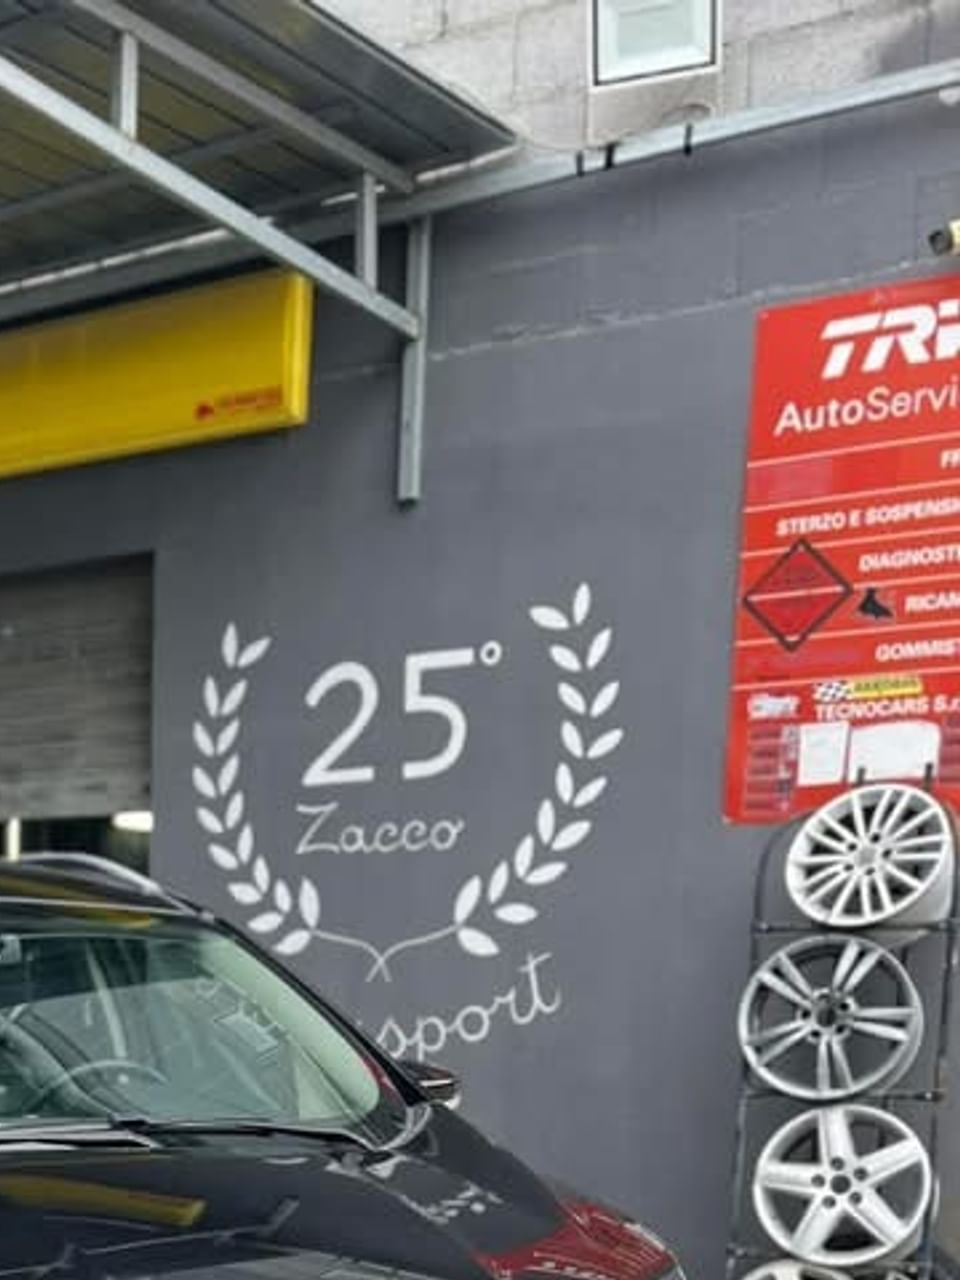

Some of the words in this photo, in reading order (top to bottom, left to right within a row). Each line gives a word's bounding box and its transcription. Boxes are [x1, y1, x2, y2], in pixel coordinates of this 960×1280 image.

[776, 510, 847, 537] STERZO
[849, 508, 862, 528] E
[295, 801, 464, 855] Zacco
